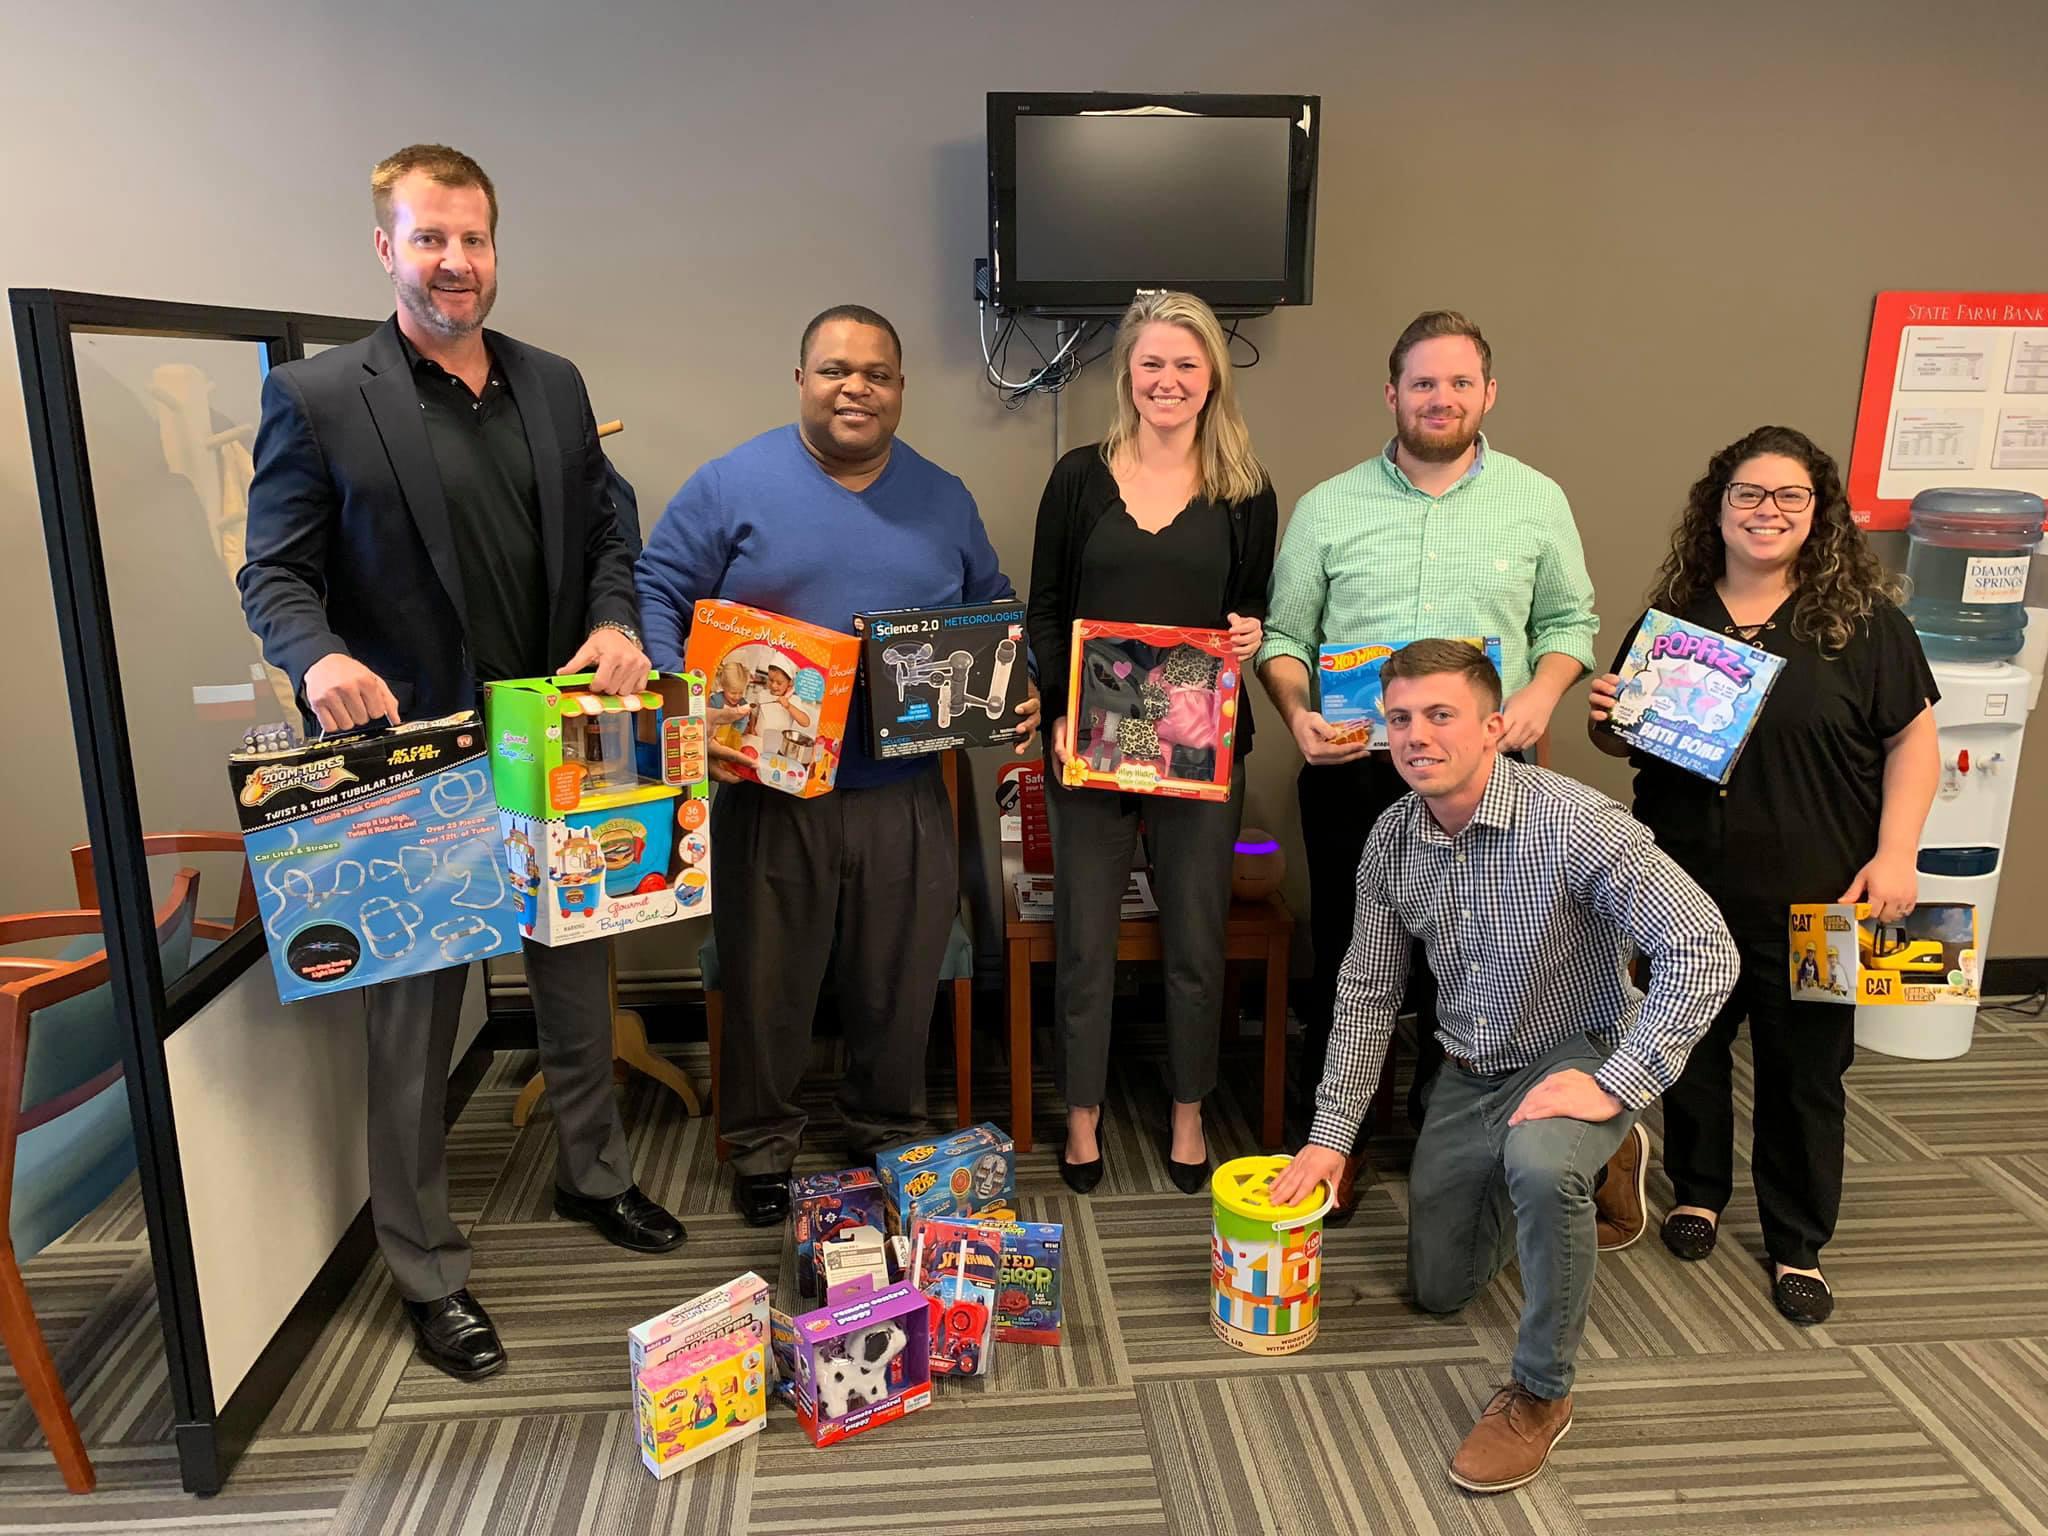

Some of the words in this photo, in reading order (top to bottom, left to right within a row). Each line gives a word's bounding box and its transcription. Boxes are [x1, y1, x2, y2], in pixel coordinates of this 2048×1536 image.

[1908, 304, 1951, 320] STATE
[1957, 304, 1998, 320] FARM
[2004, 304, 2043, 320] BANK
[1972, 565, 2027, 576] DIAMOND
[1976, 577, 2023, 588] SPRINGS
[697, 607, 752, 637] Chocolate
[754, 626, 797, 650] Maker
[876, 622, 919, 637] Science
[921, 619, 939, 632] 2.0
[945, 611, 1024, 627] METEOROLOGIST
[1335, 655, 1355, 671] HOT
[1357, 646, 1393, 664] WHEELS
[392, 749, 409, 758] RC
[410, 744, 433, 754] CAR
[1638, 722, 1679, 746] BATH
[1678, 736, 1725, 762] BOMB
[387, 754, 417, 765] TRAX
[419, 750, 441, 761] SET
[262, 769, 299, 785] ZOOM
[301, 757, 344, 774] TUBES
[301, 770, 330, 783] TRAX
[265, 806, 298, 821] TWIST
[301, 803, 309, 811] &
[310, 794, 339, 808] TURN
[340, 779, 387, 800] TUBULAR
[388, 769, 415, 785] TRAX
[313, 813, 342, 825] Infinite
[343, 805, 364, 817] Track
[365, 788, 420, 809] Configurations
[686, 806, 698, 815] 36
[426, 824, 445, 833] Over
[459, 817, 487, 827] Pieces
[420, 837, 438, 845] Over
[461, 829, 470, 837] of
[472, 826, 496, 835] Tubes
[255, 853, 270, 861] Car
[273, 850, 294, 858] Lites
[307, 842, 339, 852] Strobes
[607, 896, 649, 917] Gourmet
[596, 916, 633, 930] Burger
[635, 909, 660, 922] Cart
[1792, 914, 1812, 932] CAT
[1866, 977, 1892, 995] CAT
[832, 1301, 870, 1318] remote
[871, 1288, 910, 1305] control
[837, 1309, 872, 1325] puppy
[1231, 1338, 1244, 1348] LID
[1281, 1333, 1308, 1345] WOODEN
[1266, 1345, 1286, 1353] WITH
[845, 1408, 873, 1424] remote
[873, 1396, 902, 1413] control
[845, 1417, 871, 1432] puppy
